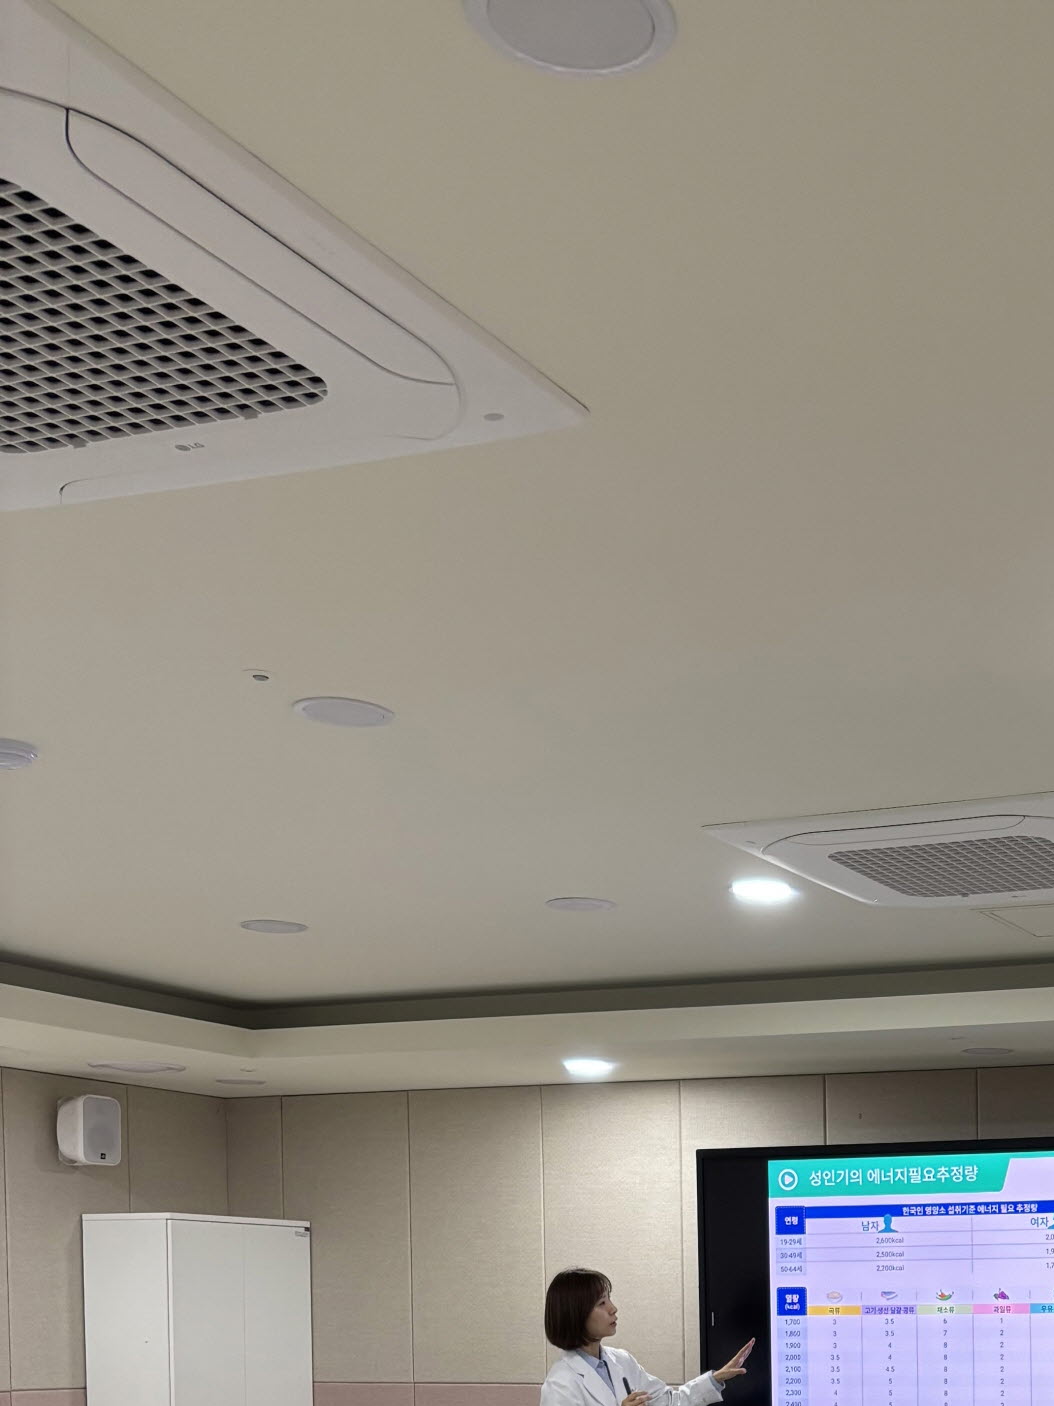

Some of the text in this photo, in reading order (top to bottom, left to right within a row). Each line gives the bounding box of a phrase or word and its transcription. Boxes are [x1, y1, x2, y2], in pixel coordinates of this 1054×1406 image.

[809, 1165, 978, 1187] 성인기의 에너지필요추정량
[902, 1203, 1038, 1216] 한국인 영양소 섭취기준 에너지 필요 추정량
[784, 1216, 798, 1225] 연령
[1030, 1217, 1049, 1227] 여자
[861, 1221, 879, 1231] 남자
